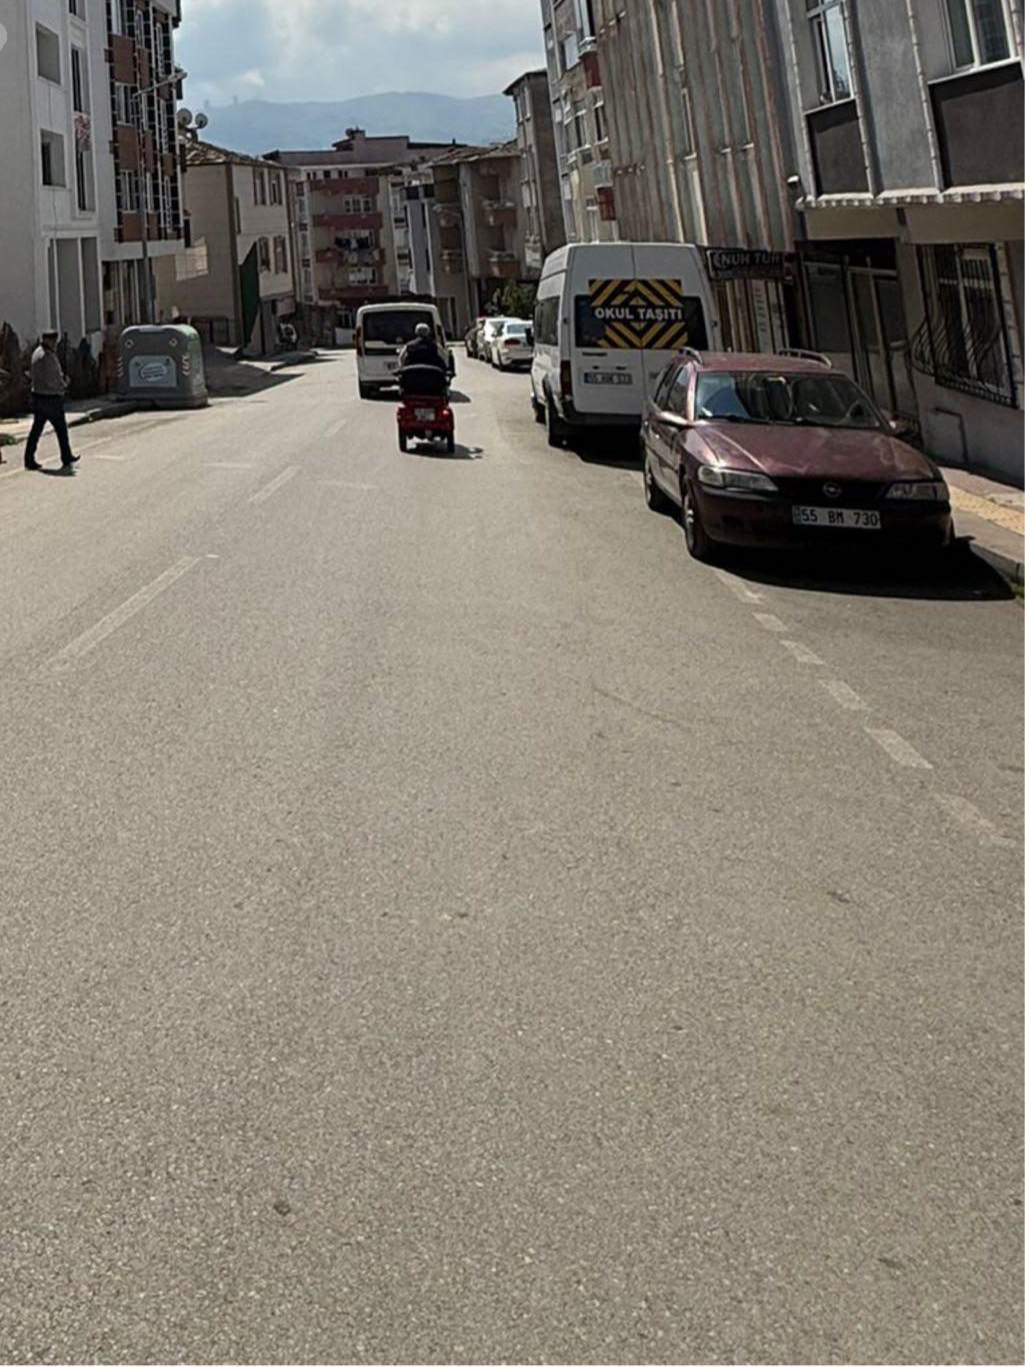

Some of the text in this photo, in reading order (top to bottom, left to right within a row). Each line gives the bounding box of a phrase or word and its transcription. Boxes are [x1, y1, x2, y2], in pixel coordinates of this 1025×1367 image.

[594, 307, 682, 321] OKUL TAŞITI
[802, 509, 879, 526] 55 BM 730
